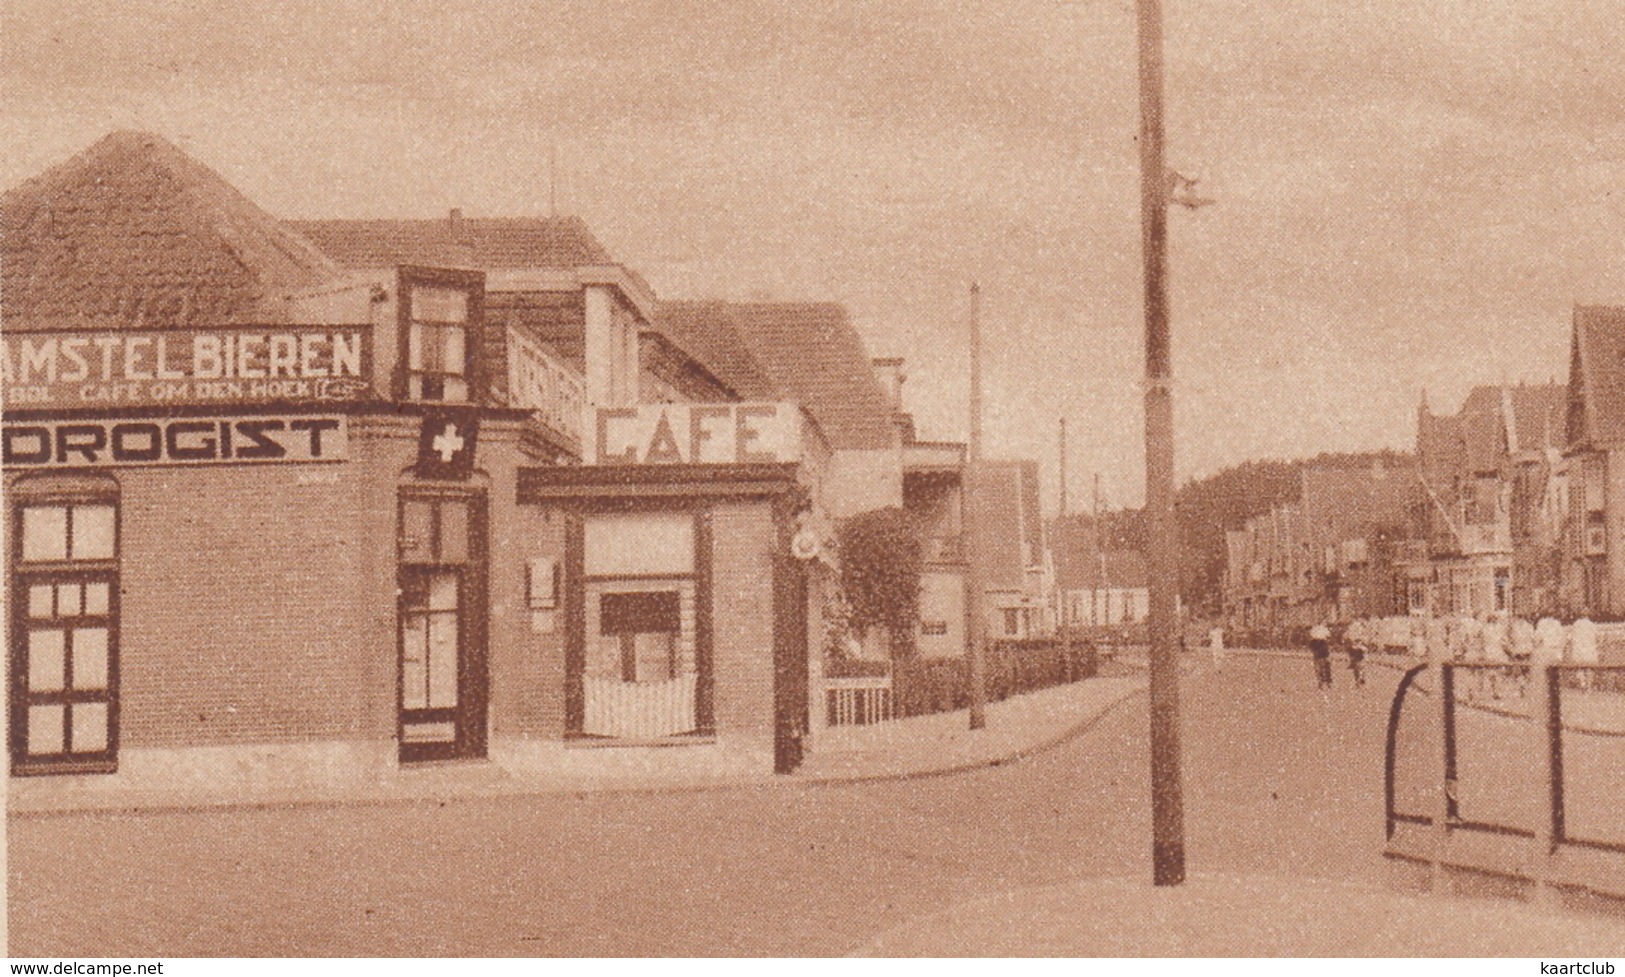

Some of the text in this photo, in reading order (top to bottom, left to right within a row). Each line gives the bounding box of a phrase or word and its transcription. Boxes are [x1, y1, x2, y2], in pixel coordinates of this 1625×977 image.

[193, 332, 361, 379] BIEREN
[3, 419, 339, 464] DROGIST
[596, 406, 777, 465] CAFE
